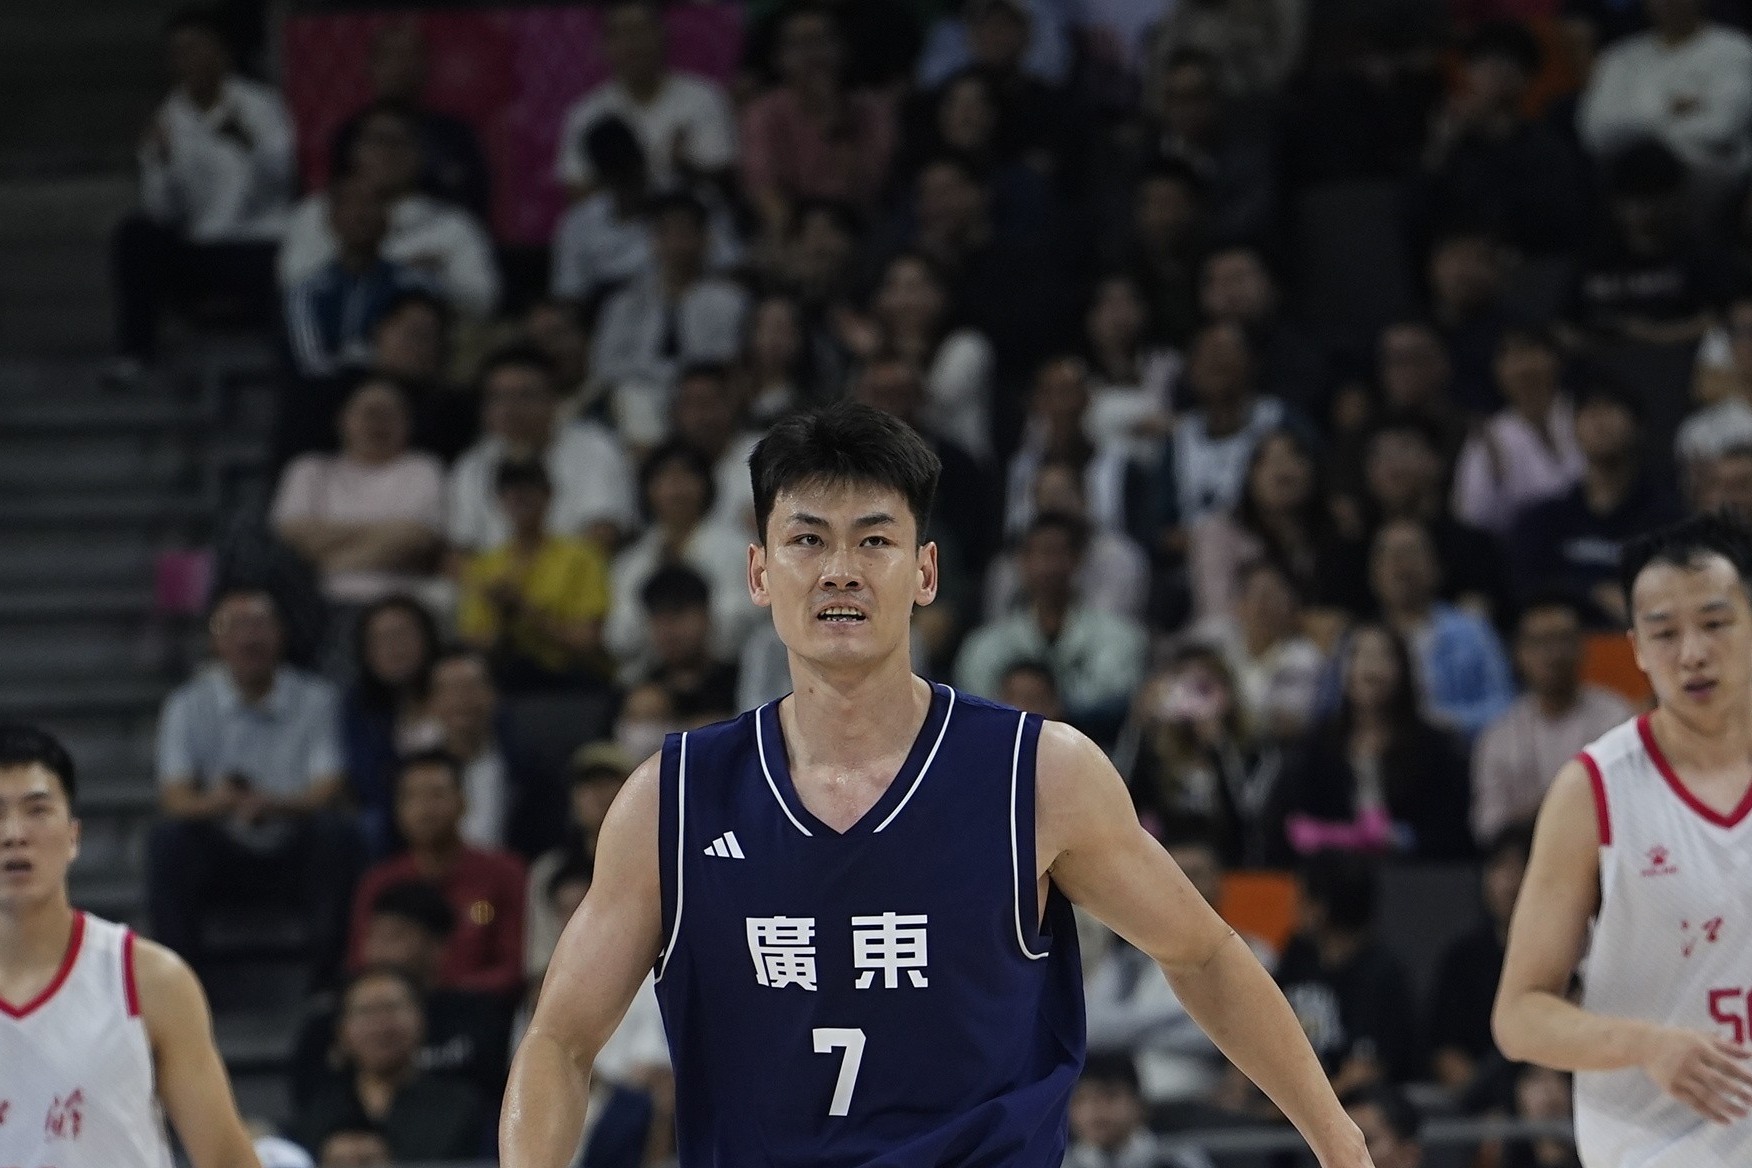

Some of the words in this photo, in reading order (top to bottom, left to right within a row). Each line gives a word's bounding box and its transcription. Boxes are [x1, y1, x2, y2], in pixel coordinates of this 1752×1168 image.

[746, 911, 929, 991] 廣東
[1708, 986, 1752, 1046] 5
[812, 1027, 867, 1117] 7
